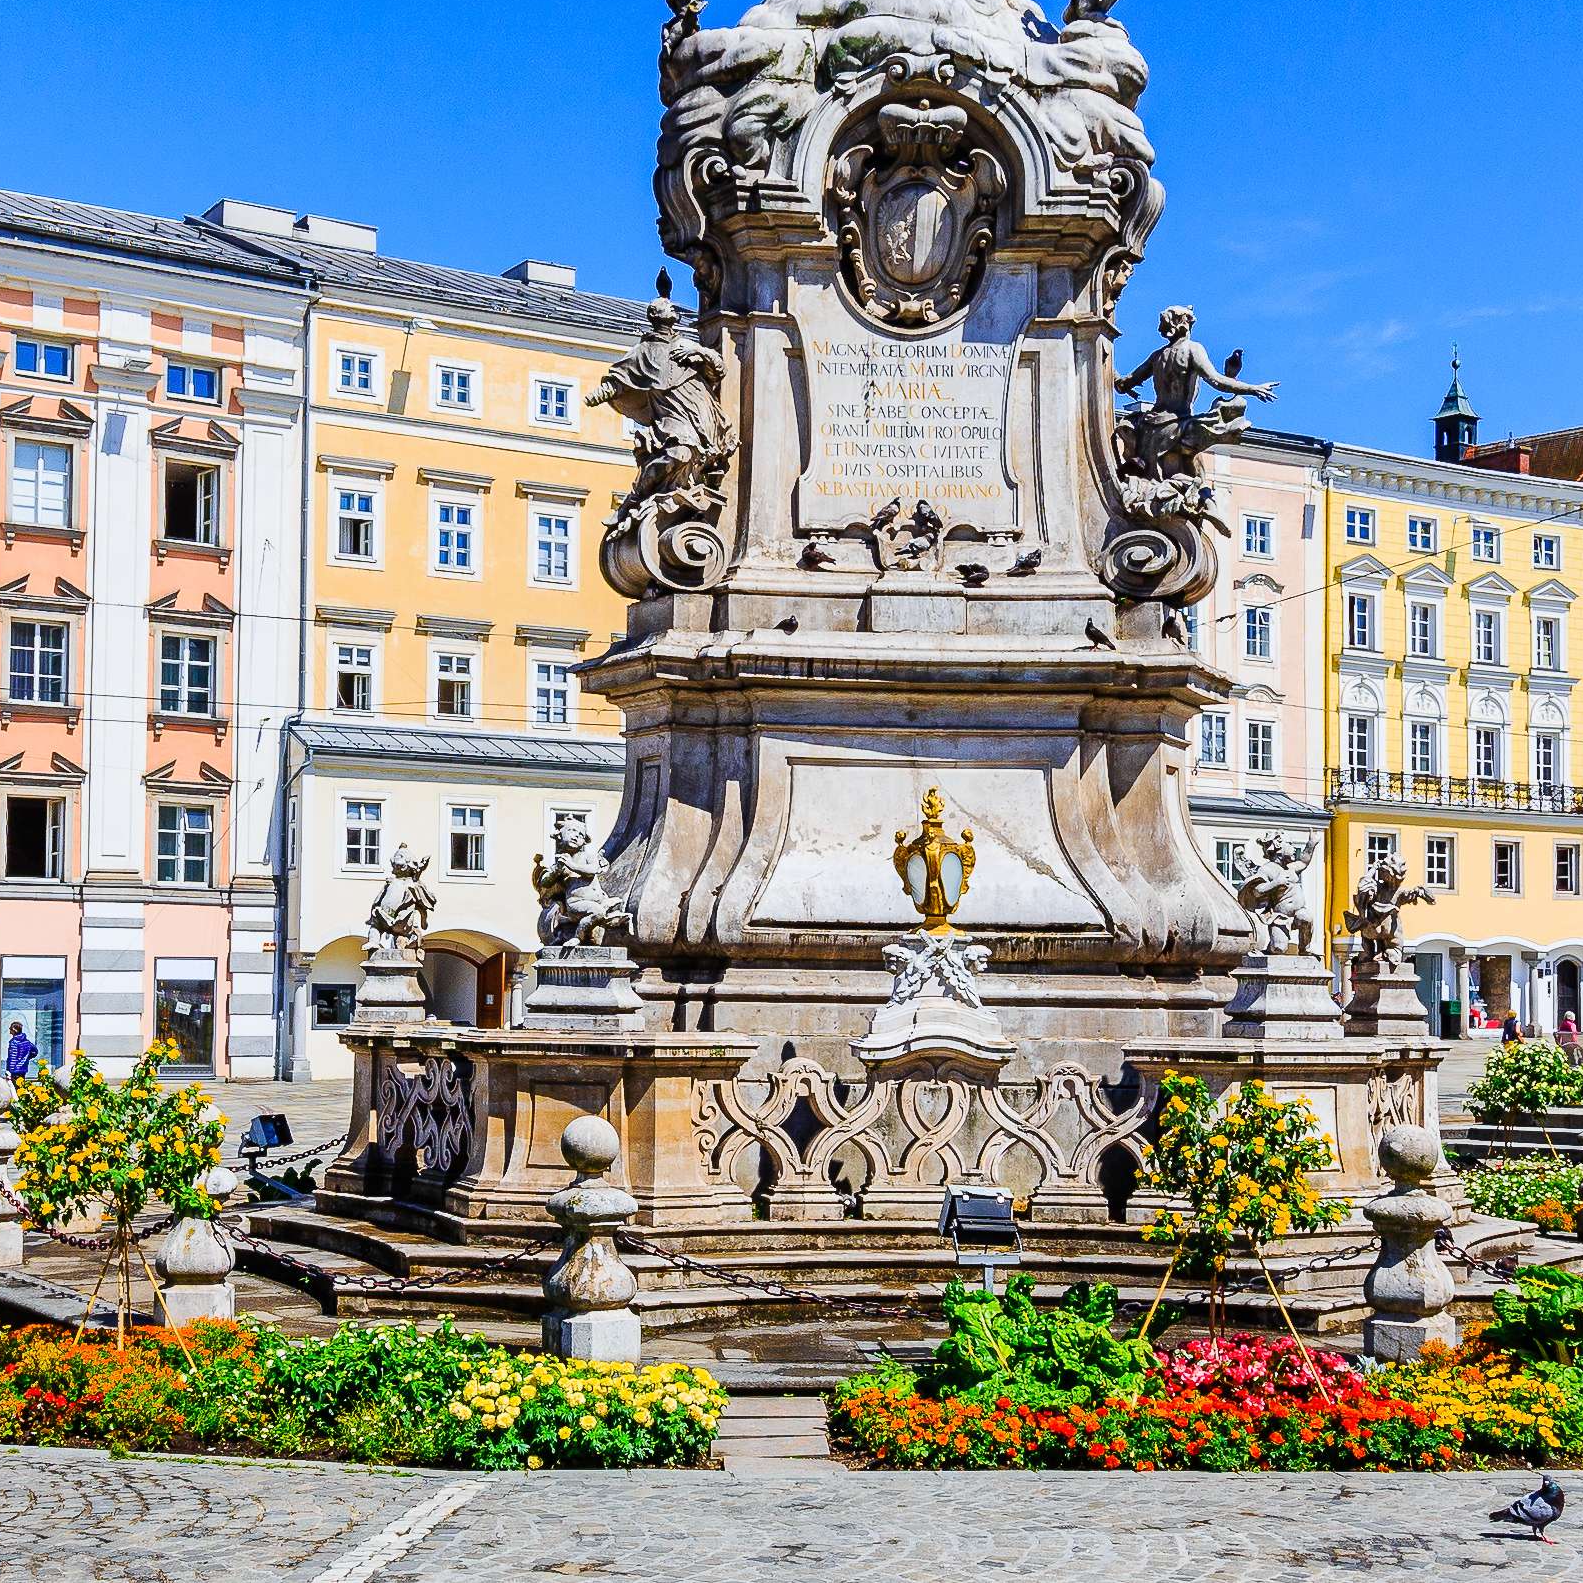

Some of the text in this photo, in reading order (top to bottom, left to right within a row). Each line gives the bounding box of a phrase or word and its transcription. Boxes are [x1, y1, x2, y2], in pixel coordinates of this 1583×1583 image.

[909, 361, 954, 378] MATRI
[957, 362, 1006, 378] VIRGINI
[828, 404, 860, 418] SINE
[825, 442, 841, 457] ET
[844, 441, 916, 458] UNIVERSA
[832, 461, 983, 478] DIVIS SOSPITALIBUS
